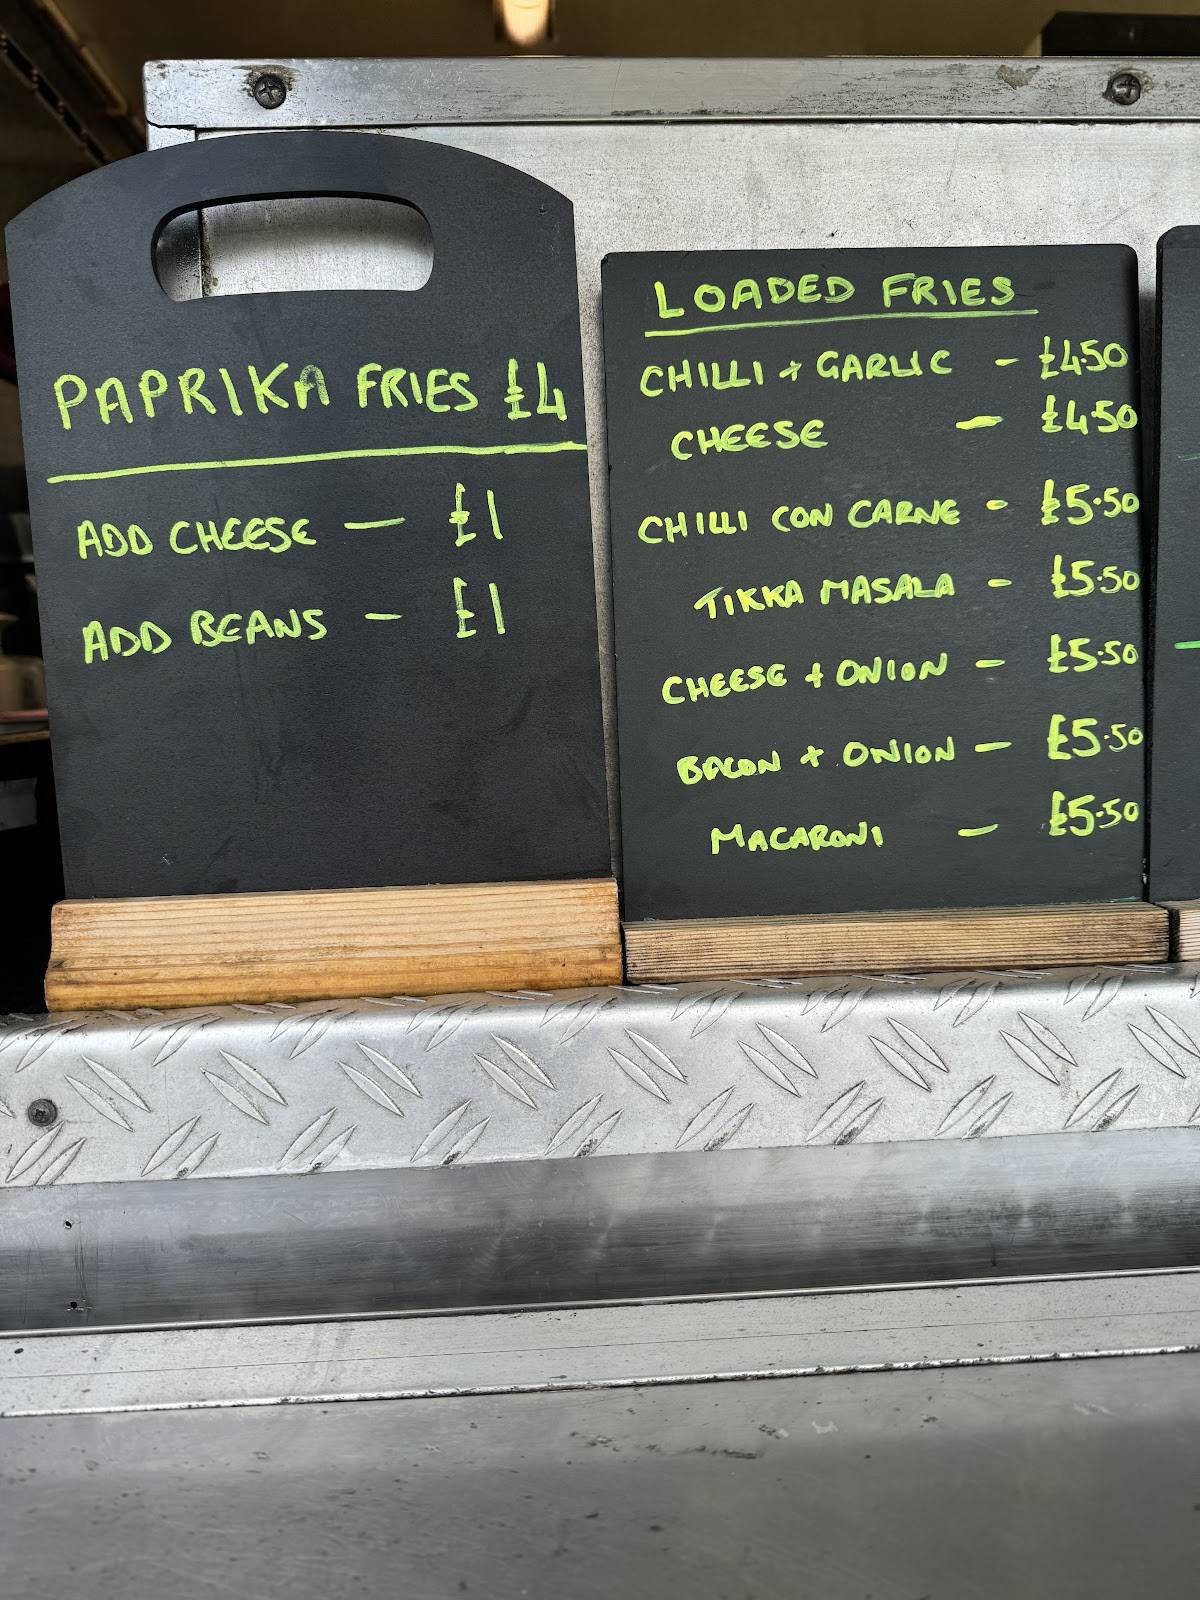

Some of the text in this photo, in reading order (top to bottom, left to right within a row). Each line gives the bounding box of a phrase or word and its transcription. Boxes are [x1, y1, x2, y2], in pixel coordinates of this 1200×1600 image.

[653, 272, 1015, 319] LOADED FRIES
[53, 358, 568, 430] PAPRIKA FRIES £4
[639, 359, 764, 397] CHILLI
[778, 361, 802, 382] +
[816, 350, 953, 382] GARLIC
[670, 418, 829, 461] CHEESE
[76, 519, 154, 560] ADD
[169, 517, 317, 555] CHEESE
[449, 482, 504, 548] £1
[637, 509, 748, 545] CHILLI
[771, 503, 833, 534] CON
[847, 498, 961, 528] CARNE
[82, 618, 172, 664] ADD
[189, 608, 327, 648] BEANS
[454, 576, 506, 639] £1
[693, 580, 805, 620] TIKKA
[820, 573, 956, 605] MASALA
[661, 662, 787, 706] CHEESE
[804, 663, 822, 690] +
[835, 651, 949, 689] ONION
[676, 750, 782, 787] BACON
[799, 746, 825, 768] +
[842, 736, 956, 767] ONION
[710, 821, 884, 854] MACARONI
